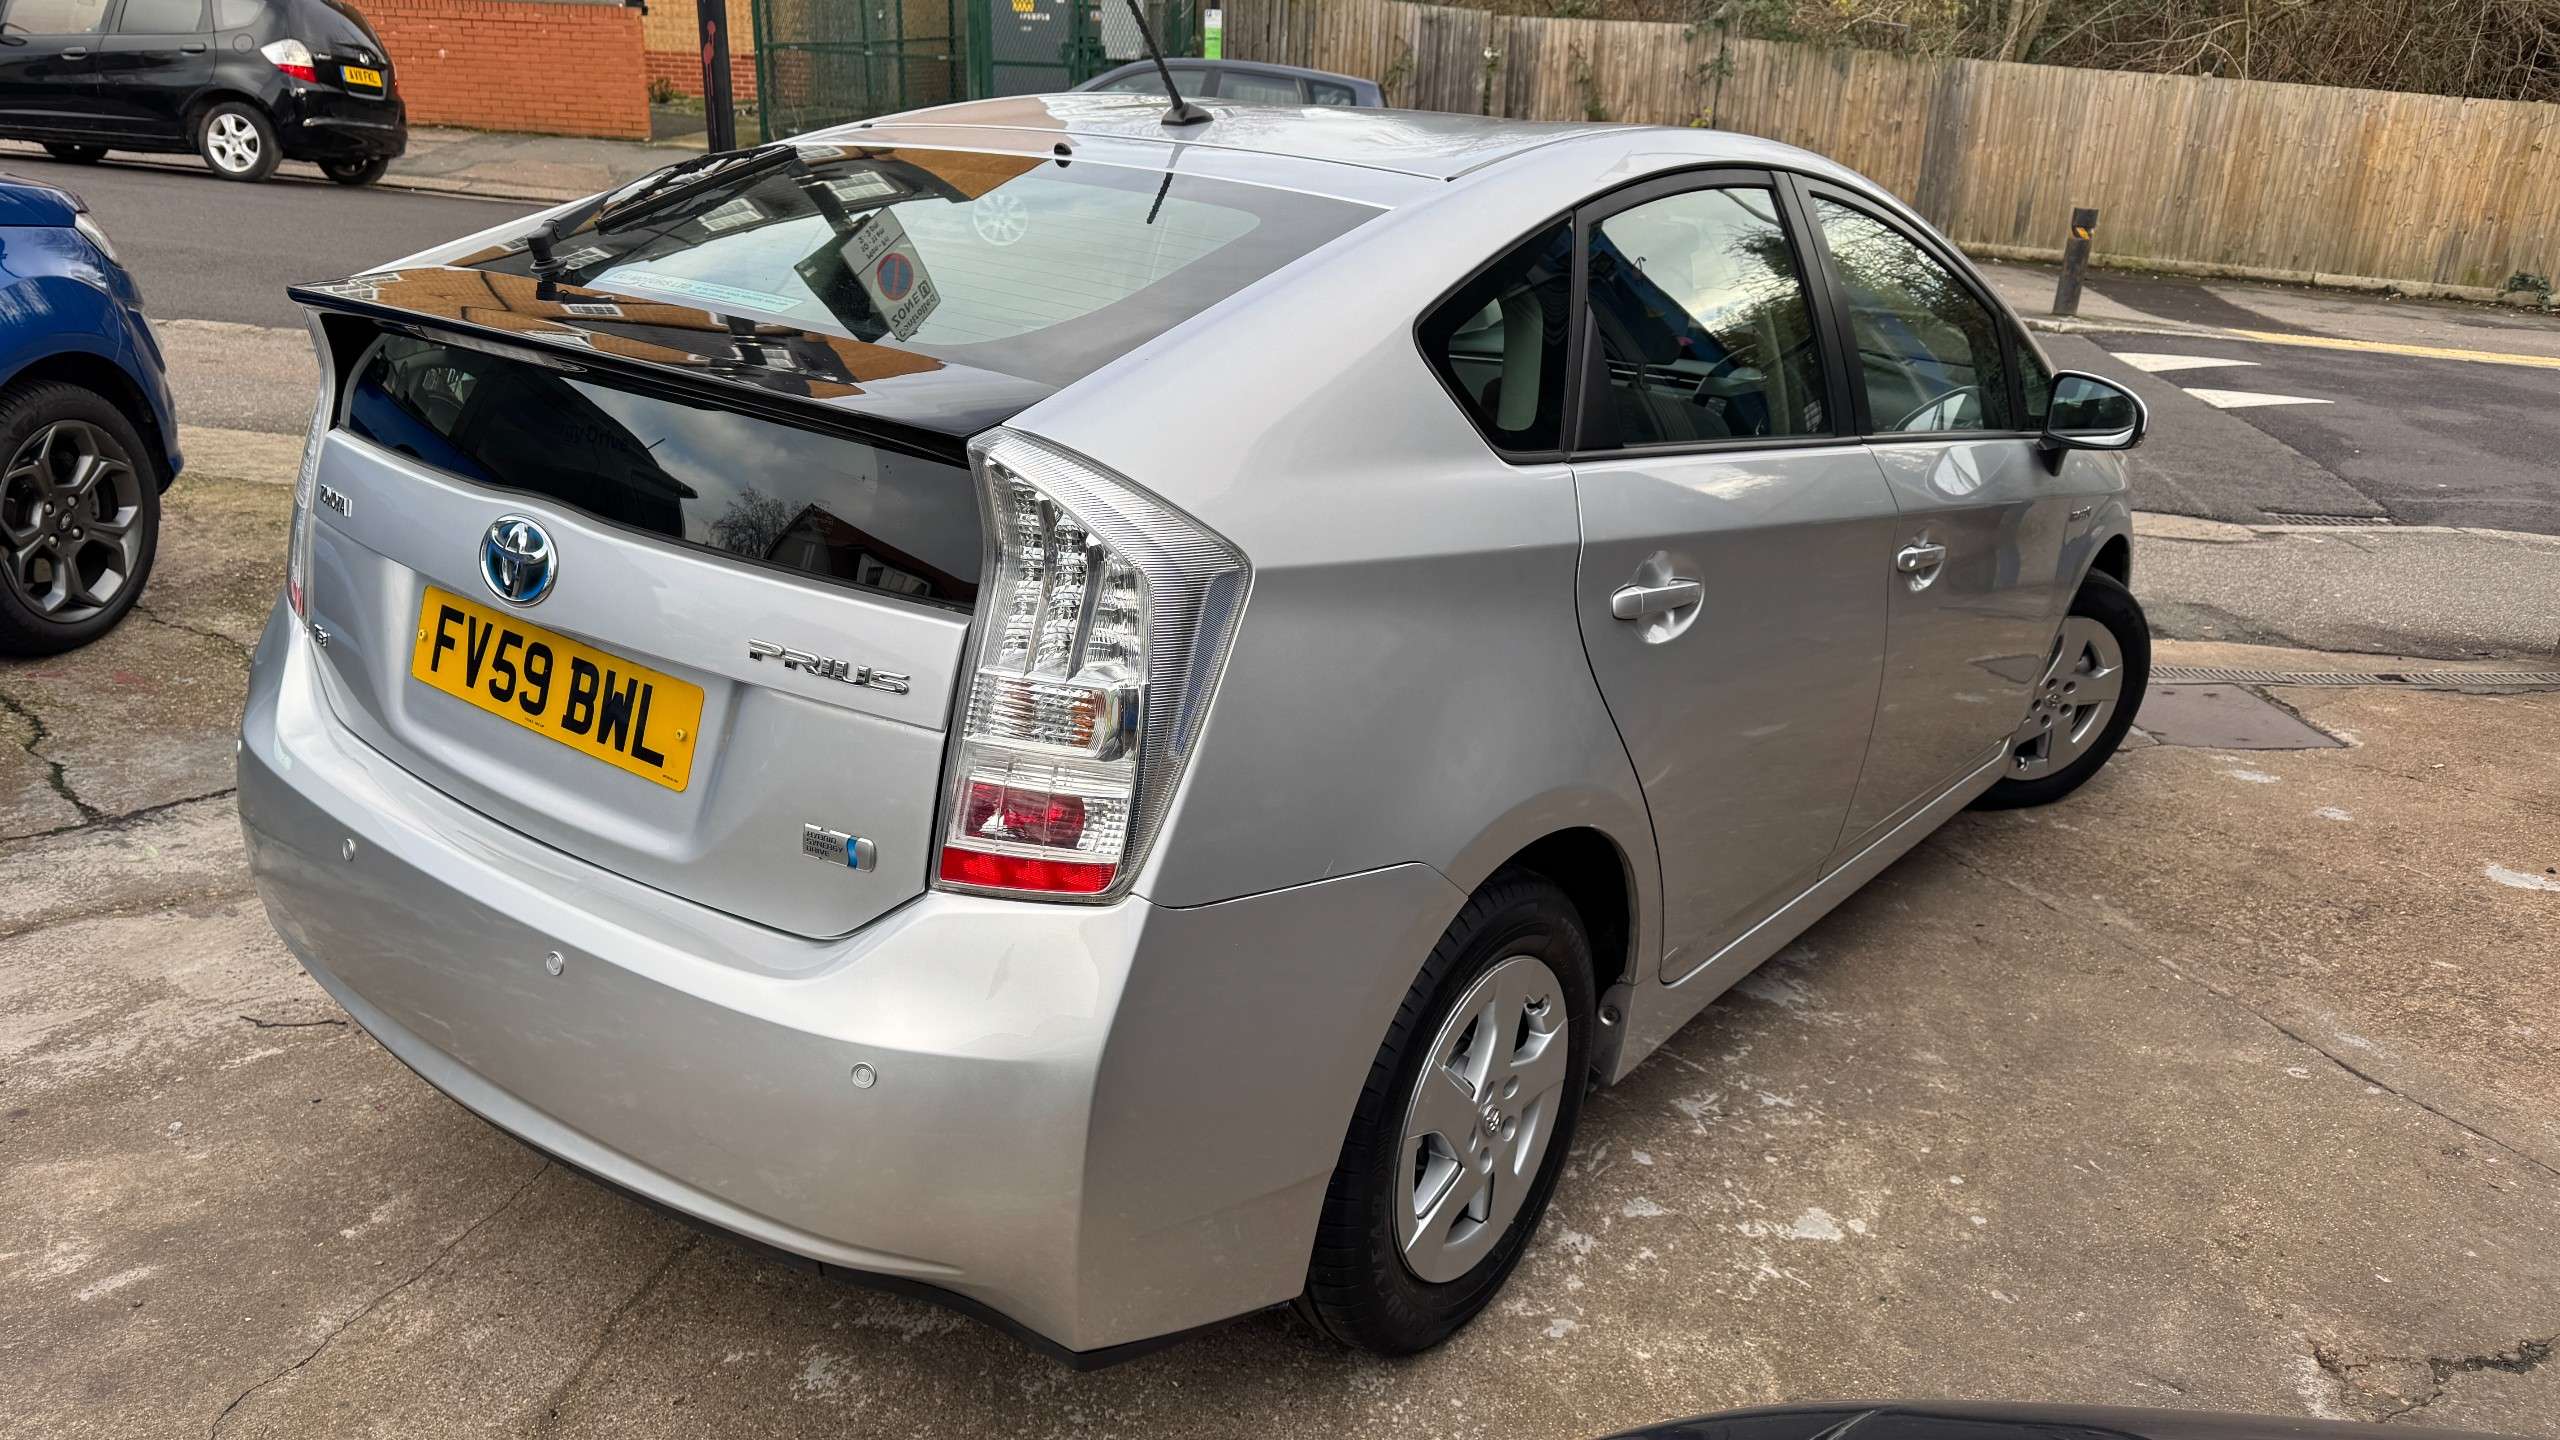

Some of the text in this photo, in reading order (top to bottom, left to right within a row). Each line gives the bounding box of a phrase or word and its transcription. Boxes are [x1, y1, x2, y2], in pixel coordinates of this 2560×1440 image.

[748, 638, 911, 695] PRIUS
[430, 603, 665, 769] FV59 BWL
[806, 831, 837, 845] HYBRID
[806, 838, 843, 853] SYNERGY
[806, 845, 830, 857] DRIVE
